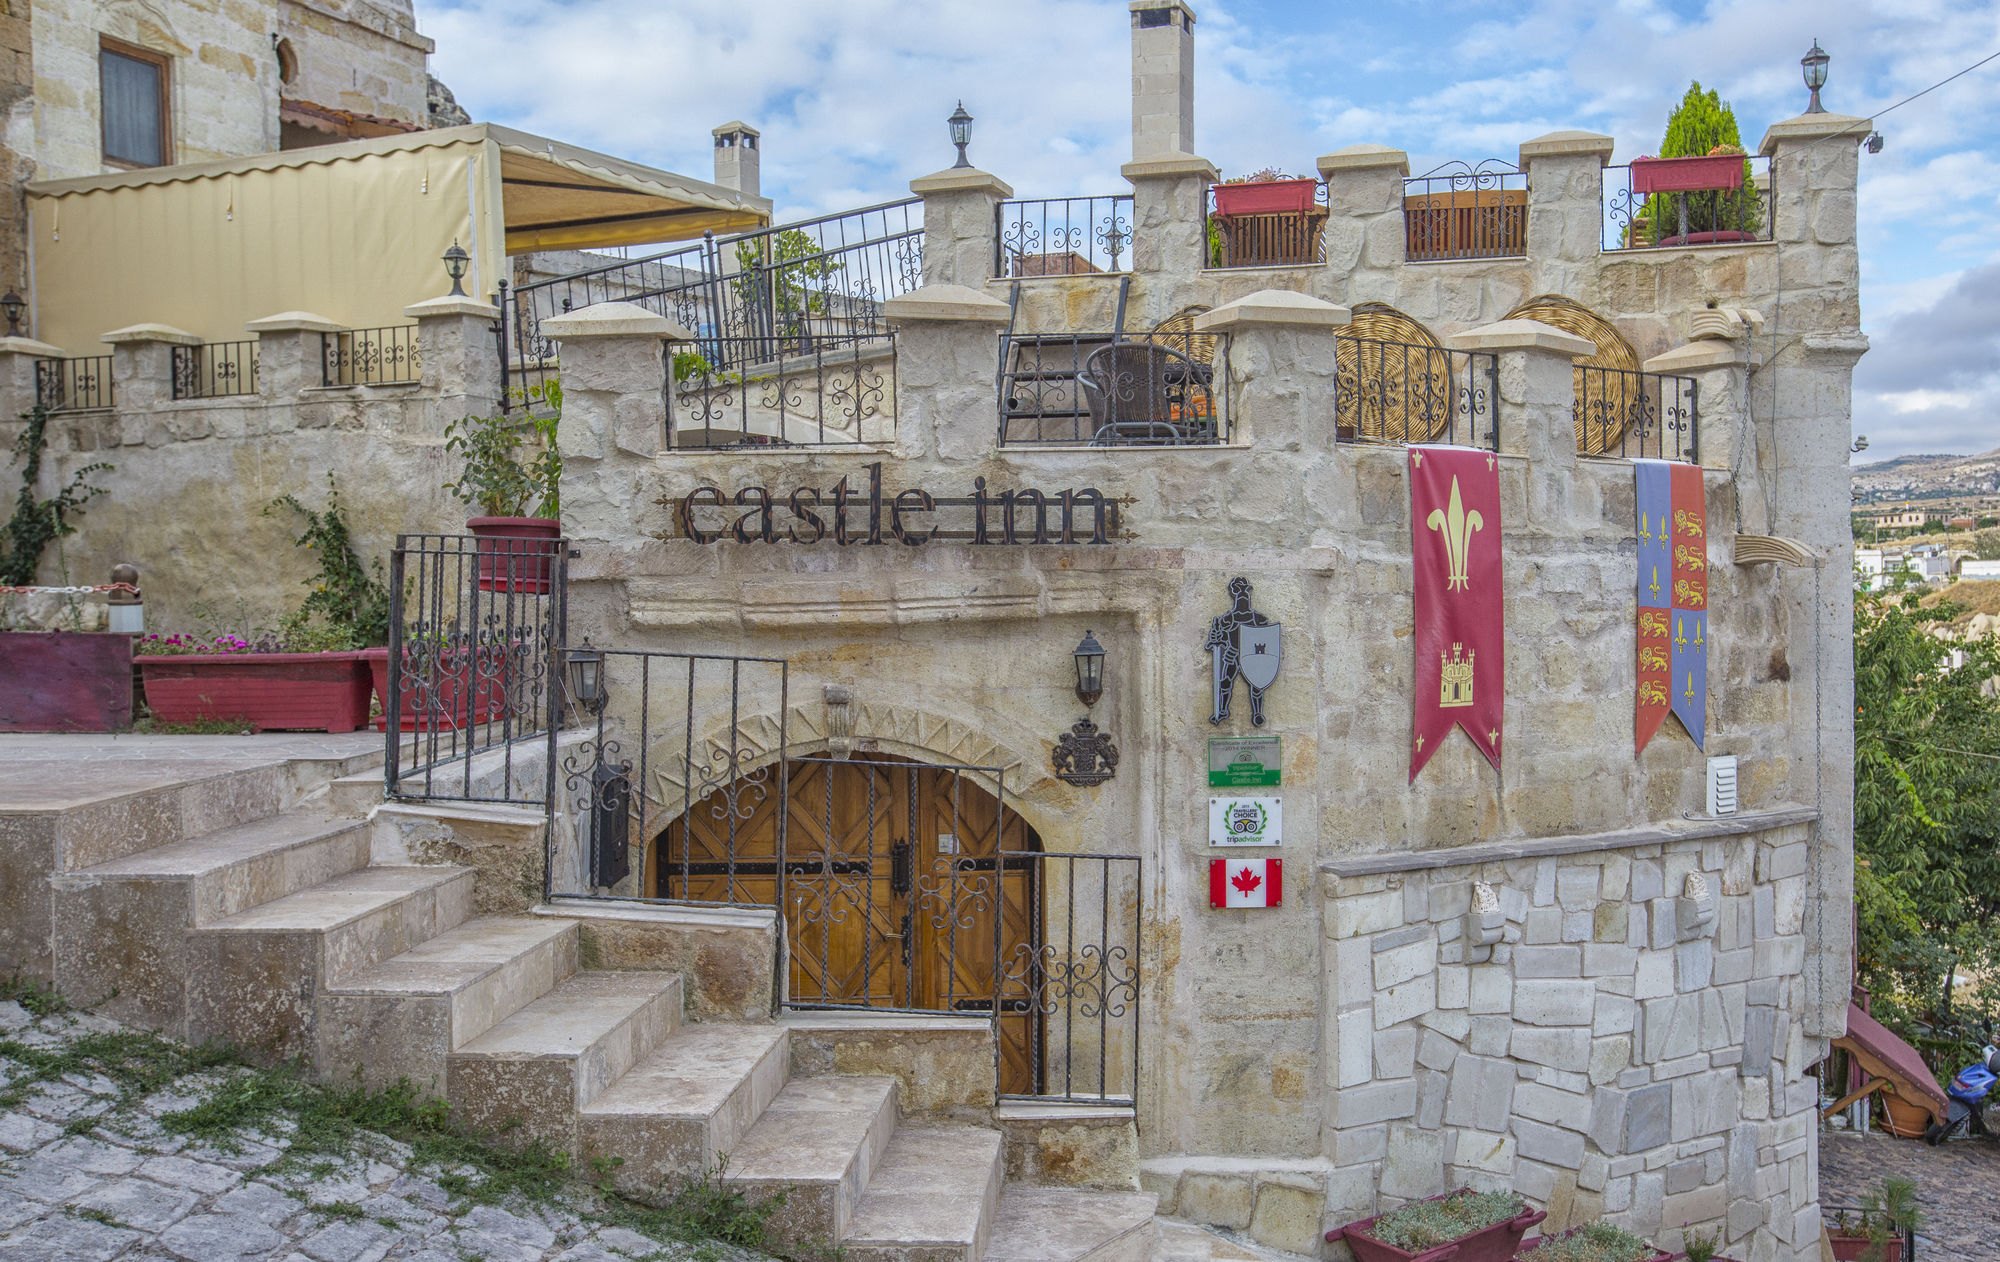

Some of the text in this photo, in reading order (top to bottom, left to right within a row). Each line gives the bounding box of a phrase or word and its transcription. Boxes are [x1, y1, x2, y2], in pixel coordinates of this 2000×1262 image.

[680, 461, 1113, 547] castle inn
[1227, 835, 1263, 844] tripadvisor
